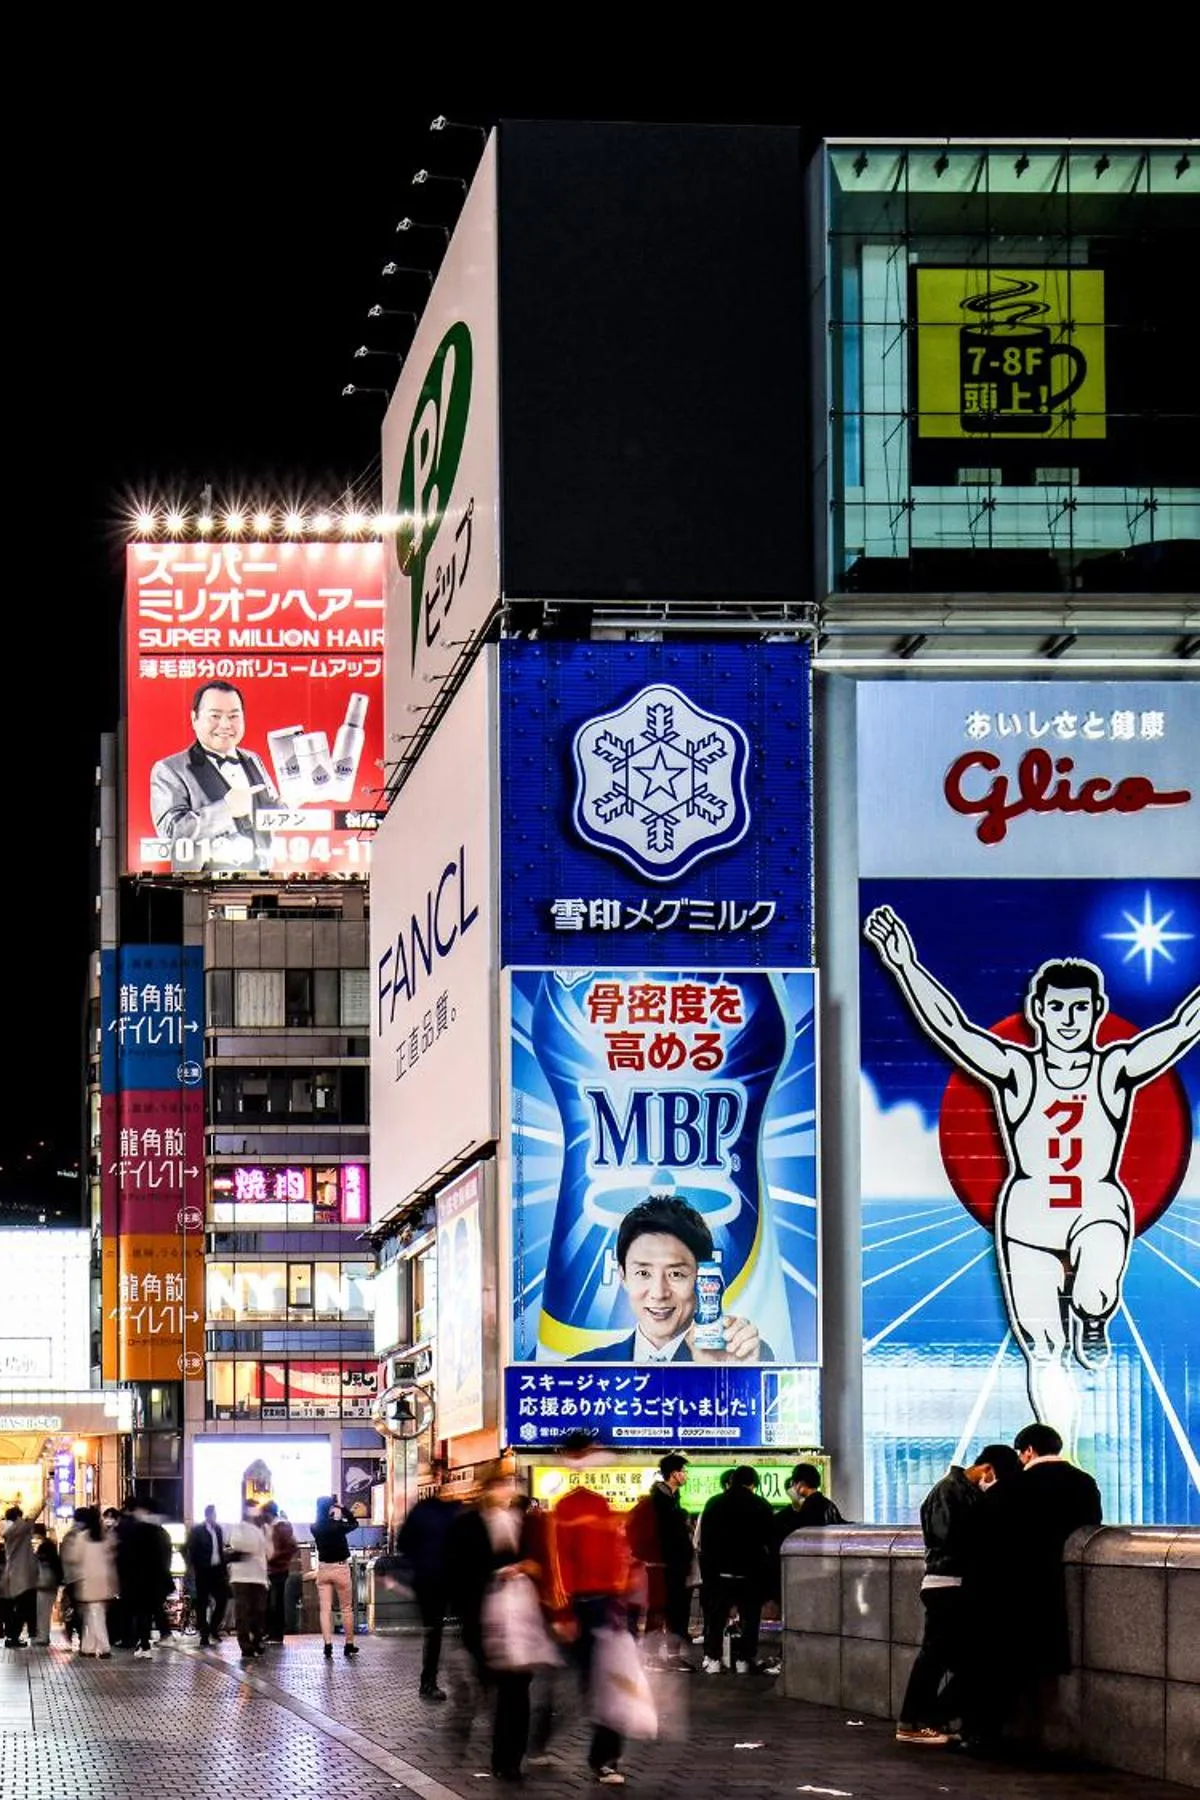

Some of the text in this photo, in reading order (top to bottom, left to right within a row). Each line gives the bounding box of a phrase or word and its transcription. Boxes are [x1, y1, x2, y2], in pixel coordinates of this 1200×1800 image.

[967, 347, 1044, 376] 7-8F
[137, 546, 278, 585] スーパー
[424, 497, 474, 648] ピップ
[139, 588, 385, 622] ミリオンヘアー
[139, 629, 385, 648] SUPER MILLION HAIR
[966, 710, 1165, 740] おいしさと健康
[550, 897, 777, 931] 雪印メグミルク
[378, 844, 479, 1037] FANCL
[120, 983, 186, 1013] 龍角散
[587, 983, 743, 1025] 骨密度を
[605, 1032, 724, 1072] 高める
[120, 1128, 186, 1158] 龍角散
[586, 1089, 741, 1169] MBP
[1045, 1093, 1088, 1209] グリコ
[119, 1272, 186, 1302] 龍角散
[519, 1373, 651, 1392] スキージャンプ
